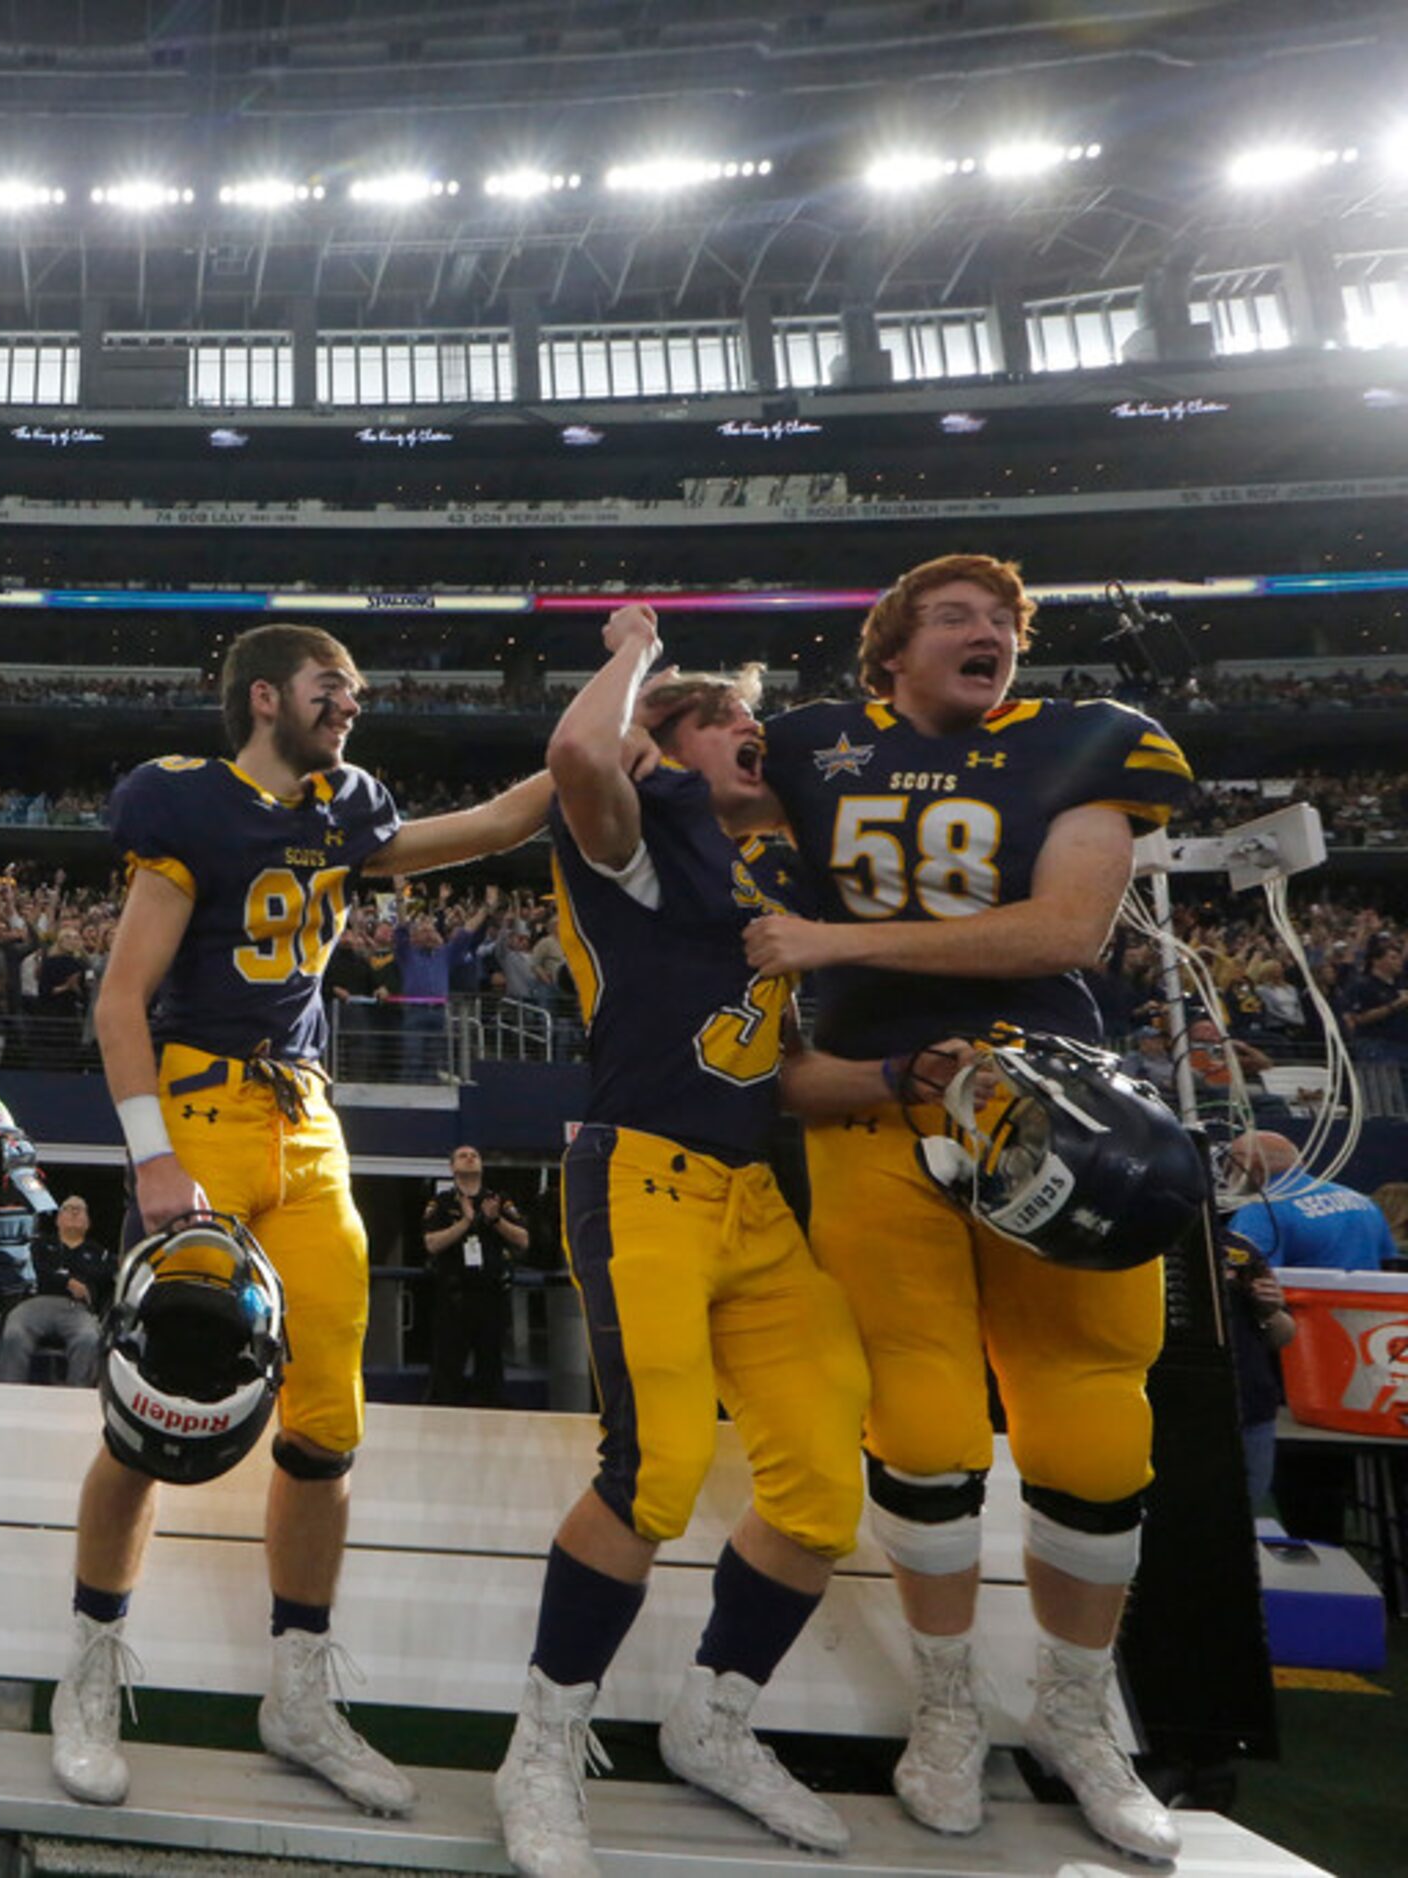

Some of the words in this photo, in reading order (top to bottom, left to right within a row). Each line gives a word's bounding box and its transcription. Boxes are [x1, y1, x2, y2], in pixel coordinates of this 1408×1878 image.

[889, 771, 959, 792] SCOTS
[285, 847, 327, 867] SCOTS
[829, 795, 1004, 921] 58
[233, 866, 351, 984] 90
[131, 1391, 231, 1434] Riddell
